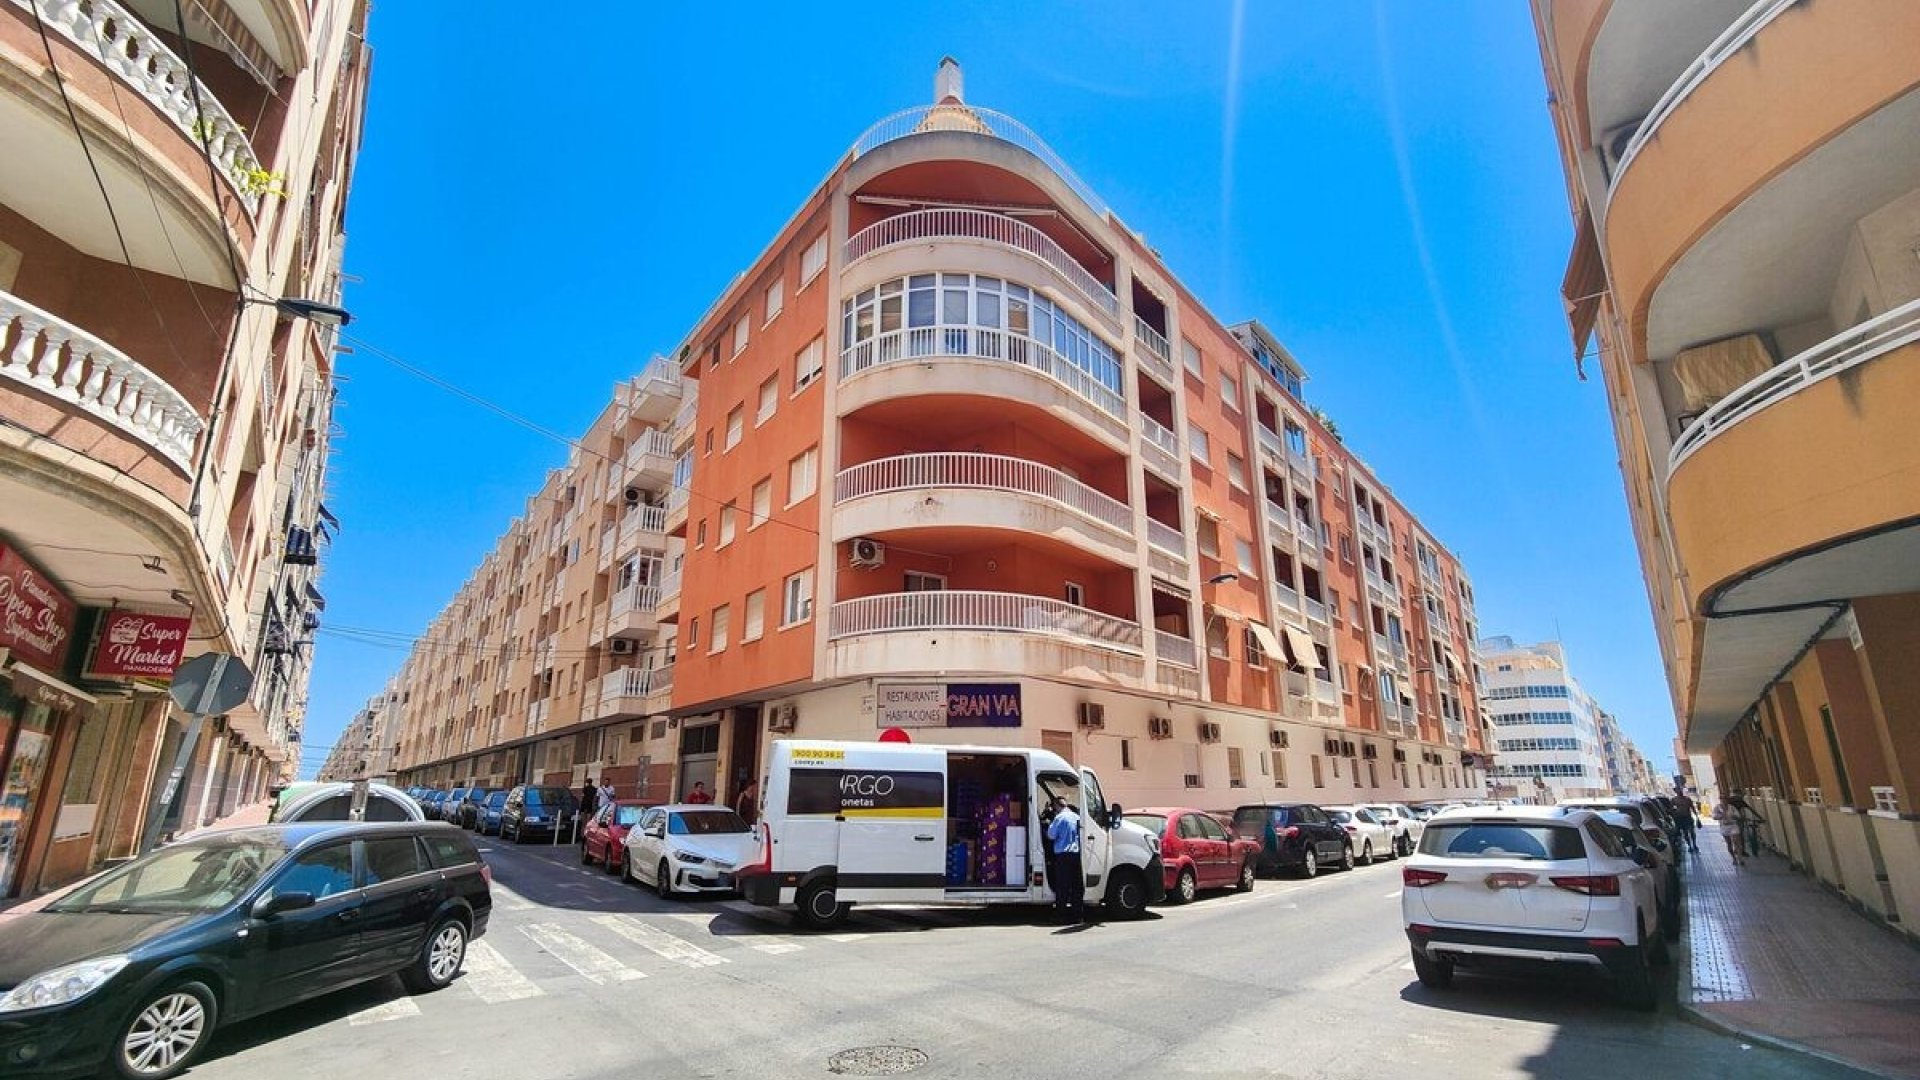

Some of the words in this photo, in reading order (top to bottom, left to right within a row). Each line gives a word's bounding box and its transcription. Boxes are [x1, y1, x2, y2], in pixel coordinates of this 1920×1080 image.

[140, 622, 182, 645] Super
[108, 643, 177, 666] Market
[886, 691, 939, 702] RESTAURANTE
[948, 693, 990, 717] GRAN
[992, 693, 1020, 717] VIA
[840, 774, 894, 796] RGO
